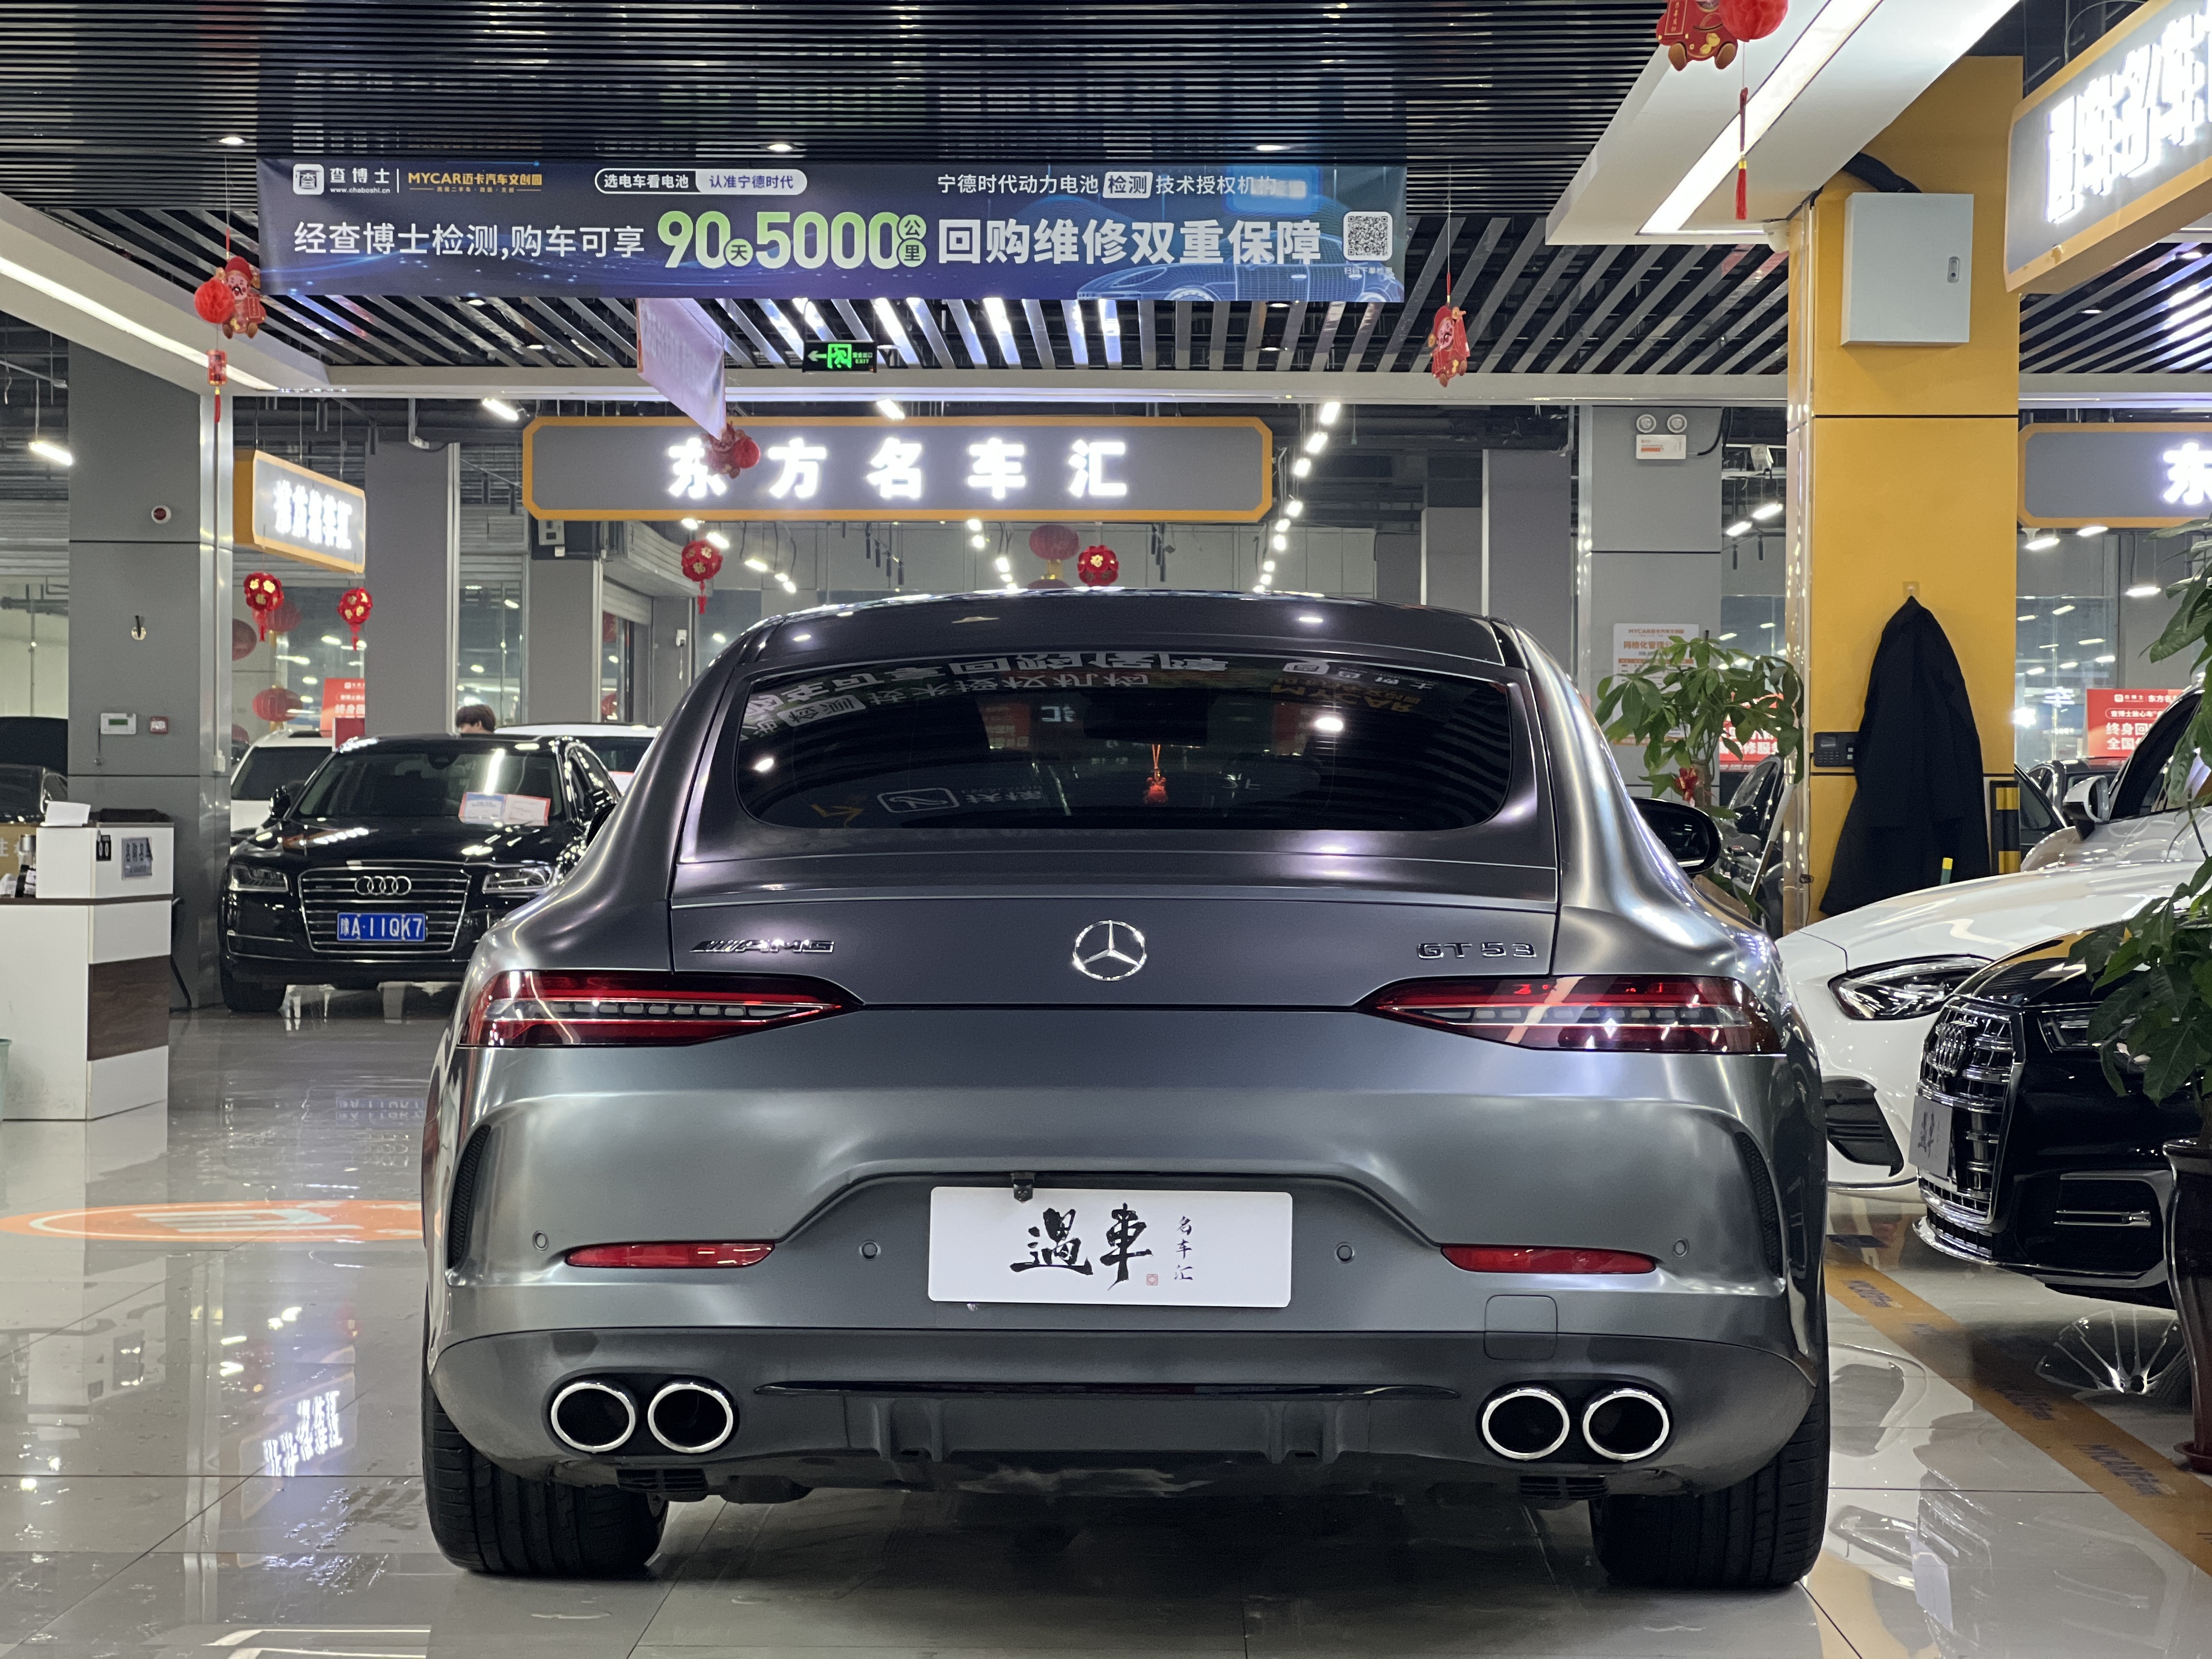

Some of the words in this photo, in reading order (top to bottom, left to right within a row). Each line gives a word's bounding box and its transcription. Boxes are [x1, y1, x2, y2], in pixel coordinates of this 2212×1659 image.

[330, 168, 390, 184] 查博士
[604, 174, 689, 189] 选电车看电池
[709, 174, 794, 190] 认准宁德时代
[937, 174, 1098, 195] 宁德时代动力电池
[1108, 174, 1148, 195] 检测
[1156, 174, 1277, 195] 技术授权机构
[294, 221, 645, 261] 经查博士检测,购车可享
[658, 211, 731, 269] 90
[731, 245, 747, 261] 天
[756, 211, 900, 269] 5000
[903, 220, 921, 262] 公里
[938, 218, 1321, 265] 回购维修双重保障
[669, 438, 1128, 499] 东方名车汇
[1623, 641, 1673, 650] 网格化管理公
[2106, 723, 2152, 736] 终身回
[733, 939, 834, 953] AMG
[1417, 942, 1472, 959] GT
[1481, 942, 1537, 958] 53
[1174, 1216, 1193, 1281] 名车汇
